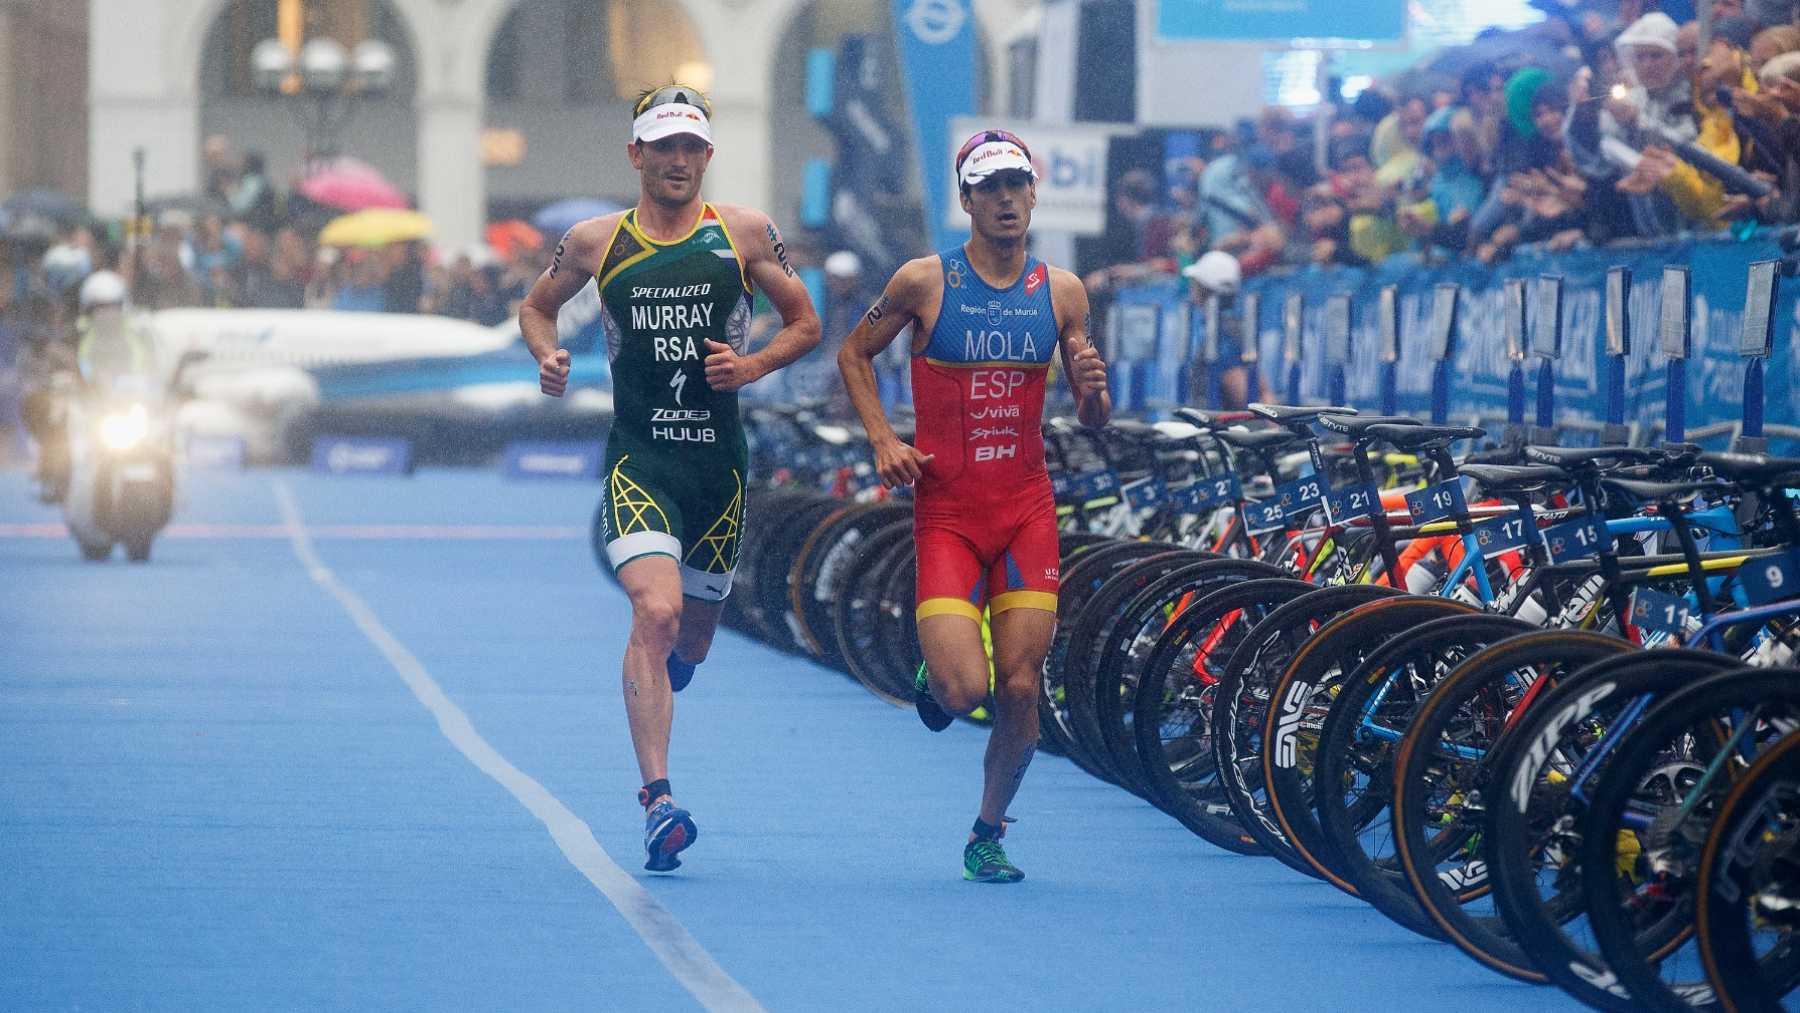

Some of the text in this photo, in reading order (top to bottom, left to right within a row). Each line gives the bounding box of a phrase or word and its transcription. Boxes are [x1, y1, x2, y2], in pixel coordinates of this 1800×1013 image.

[630, 283, 711, 298] SPECIALIZED
[631, 302, 714, 330] MURRAY
[1003, 308, 1013, 316] de
[654, 336, 699, 361] RSA
[965, 330, 1038, 360] MOLA
[970, 371, 1025, 400] ESP
[652, 427, 715, 442] HUUB
[975, 443, 1017, 462] BH
[1299, 482, 1320, 501] 23
[1350, 491, 1370, 509] 21
[1433, 490, 1453, 509] 19
[1263, 504, 1284, 521] 25
[1502, 519, 1522, 540] 17
[1575, 525, 1598, 547] 15
[1765, 565, 1784, 588] 9
[1664, 604, 1689, 627] 11
[1510, 681, 1618, 814] ZIPP
